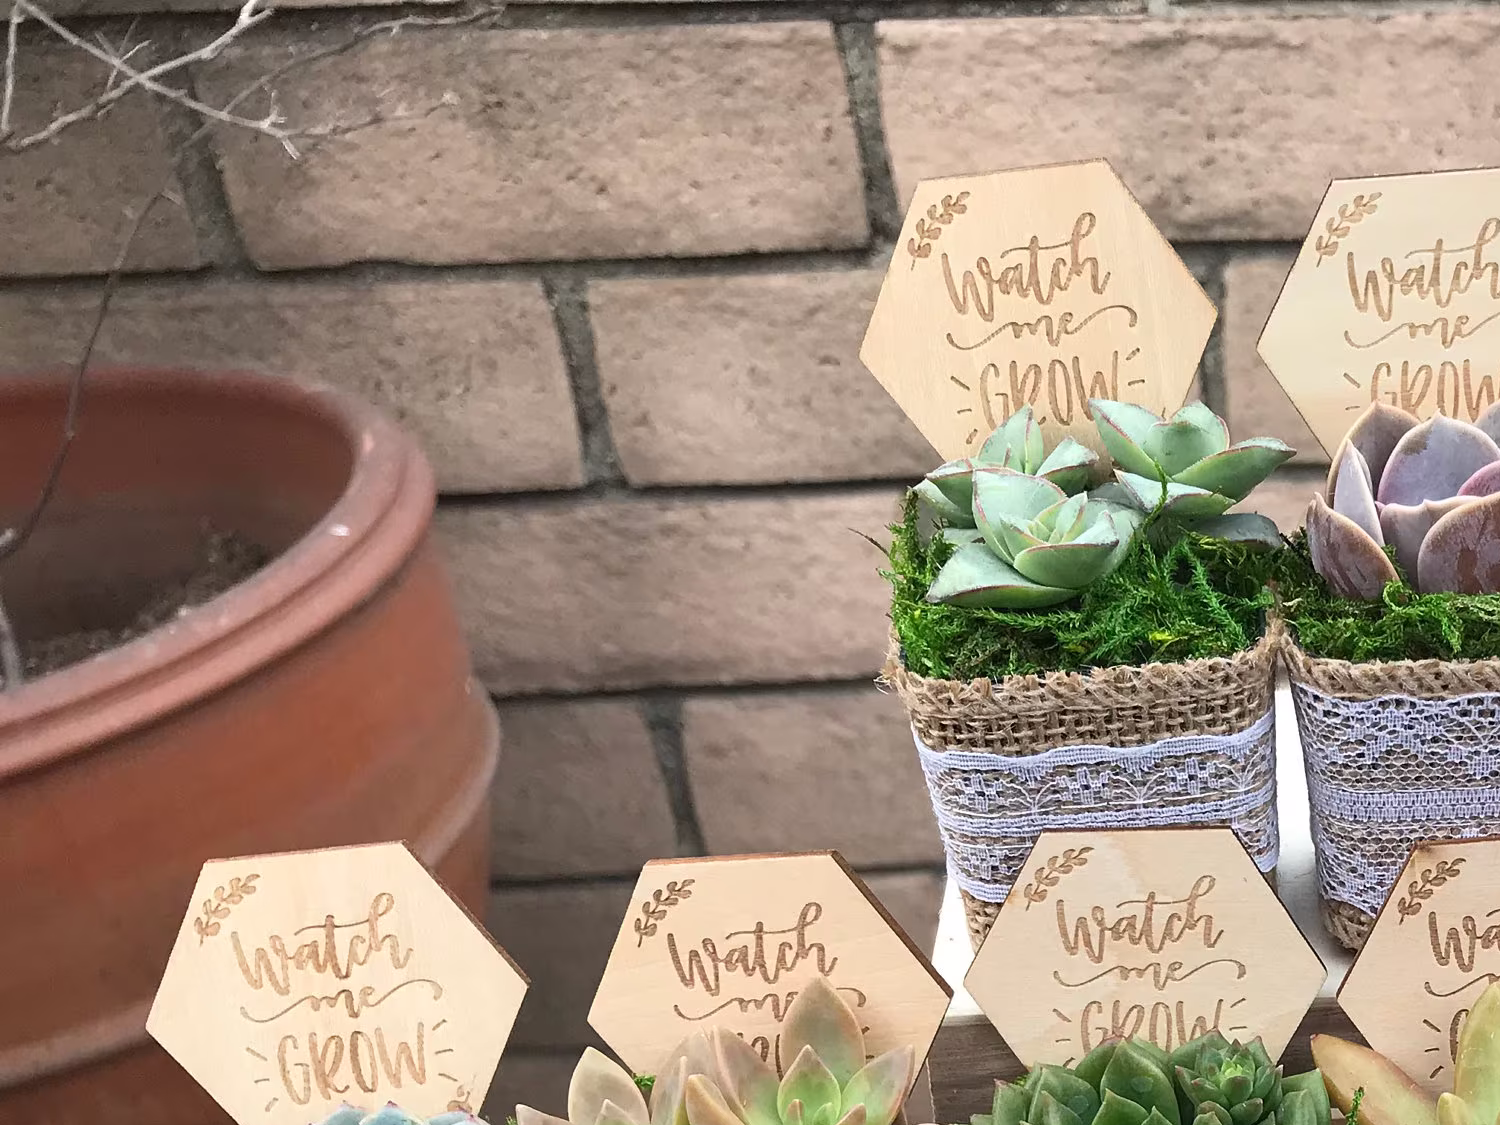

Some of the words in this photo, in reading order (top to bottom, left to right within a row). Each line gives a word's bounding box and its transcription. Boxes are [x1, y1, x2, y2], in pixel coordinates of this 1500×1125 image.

[942, 212, 1110, 322] Watch
[980, 351, 1118, 430] GROW
[231, 892, 414, 996] Watch
[667, 902, 838, 996] Watch
[1056, 875, 1224, 964] Watch
[277, 1022, 426, 1105] GROW
